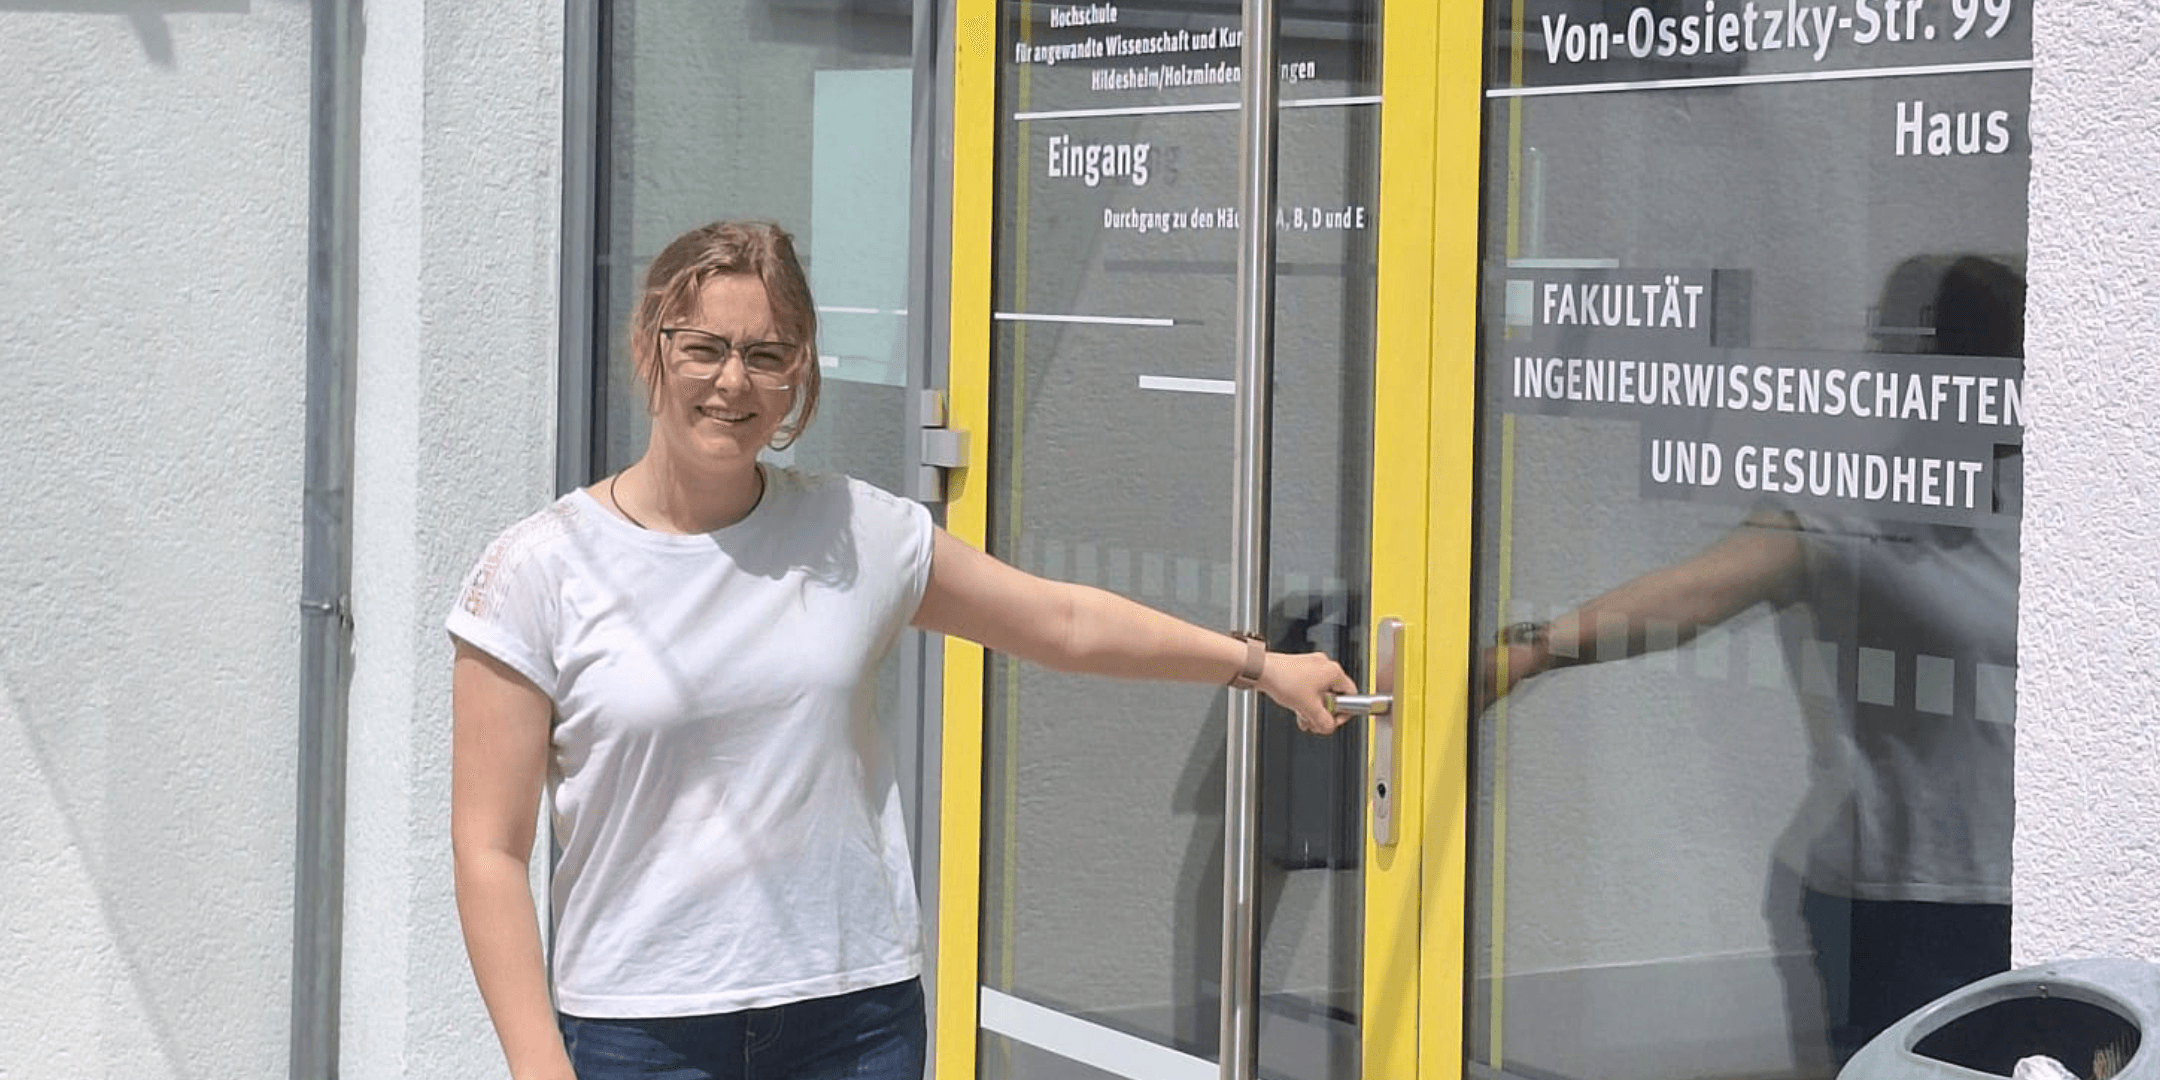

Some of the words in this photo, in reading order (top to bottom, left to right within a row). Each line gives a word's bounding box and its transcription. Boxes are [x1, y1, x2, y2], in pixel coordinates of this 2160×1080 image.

[1050, 3, 1118, 28] Hochschule
[1953, 0, 2012, 41] 99
[1015, 42, 1032, 63] für
[1034, 36, 1104, 66] angewandte
[1105, 29, 1190, 57] Wissenschaft
[1192, 27, 1216, 50] und
[1895, 100, 2009, 156] Haus
[1048, 134, 1150, 187] Eingang
[1104, 207, 1170, 233] Durchgang
[1172, 212, 1188, 229] zu
[1190, 207, 1213, 229] den
[1276, 207, 1290, 231] A,
[1293, 207, 1308, 232] B,
[1312, 207, 1322, 229] D
[1325, 206, 1352, 229] und
[1355, 207, 1365, 229] E
[1543, 274, 1704, 329] FAKULTÄT
[1513, 356, 2025, 427] INGENIEURWISSENSCHAFTEN
[1652, 439, 1722, 486] UND
[1734, 445, 1984, 509] GESUNDHEIT
